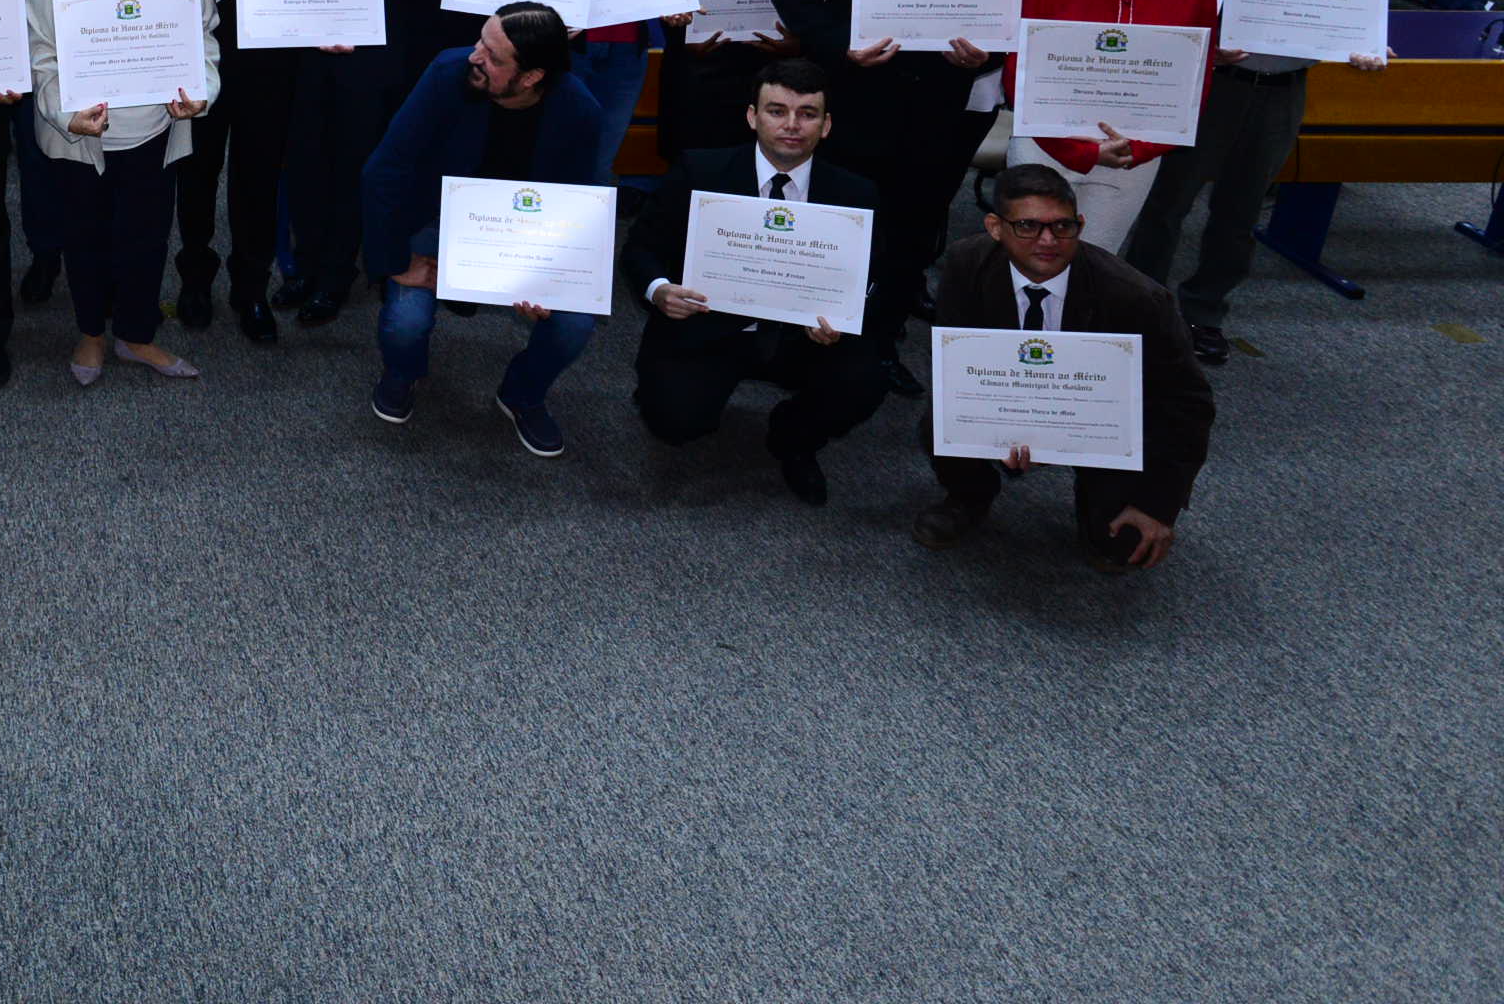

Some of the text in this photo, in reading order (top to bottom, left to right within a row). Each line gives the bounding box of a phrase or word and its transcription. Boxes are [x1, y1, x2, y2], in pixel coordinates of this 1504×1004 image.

[1047, 53, 1084, 62] Diploma
[1098, 56, 1126, 65] Honra
[1143, 59, 1173, 68] Mérito
[716, 228, 752, 239] Diploma
[767, 234, 794, 245] Honra
[810, 241, 838, 251] Mérito
[967, 366, 1006, 377] Diploma
[1024, 369, 1055, 380] Honra
[1073, 372, 1106, 382] Mérito
